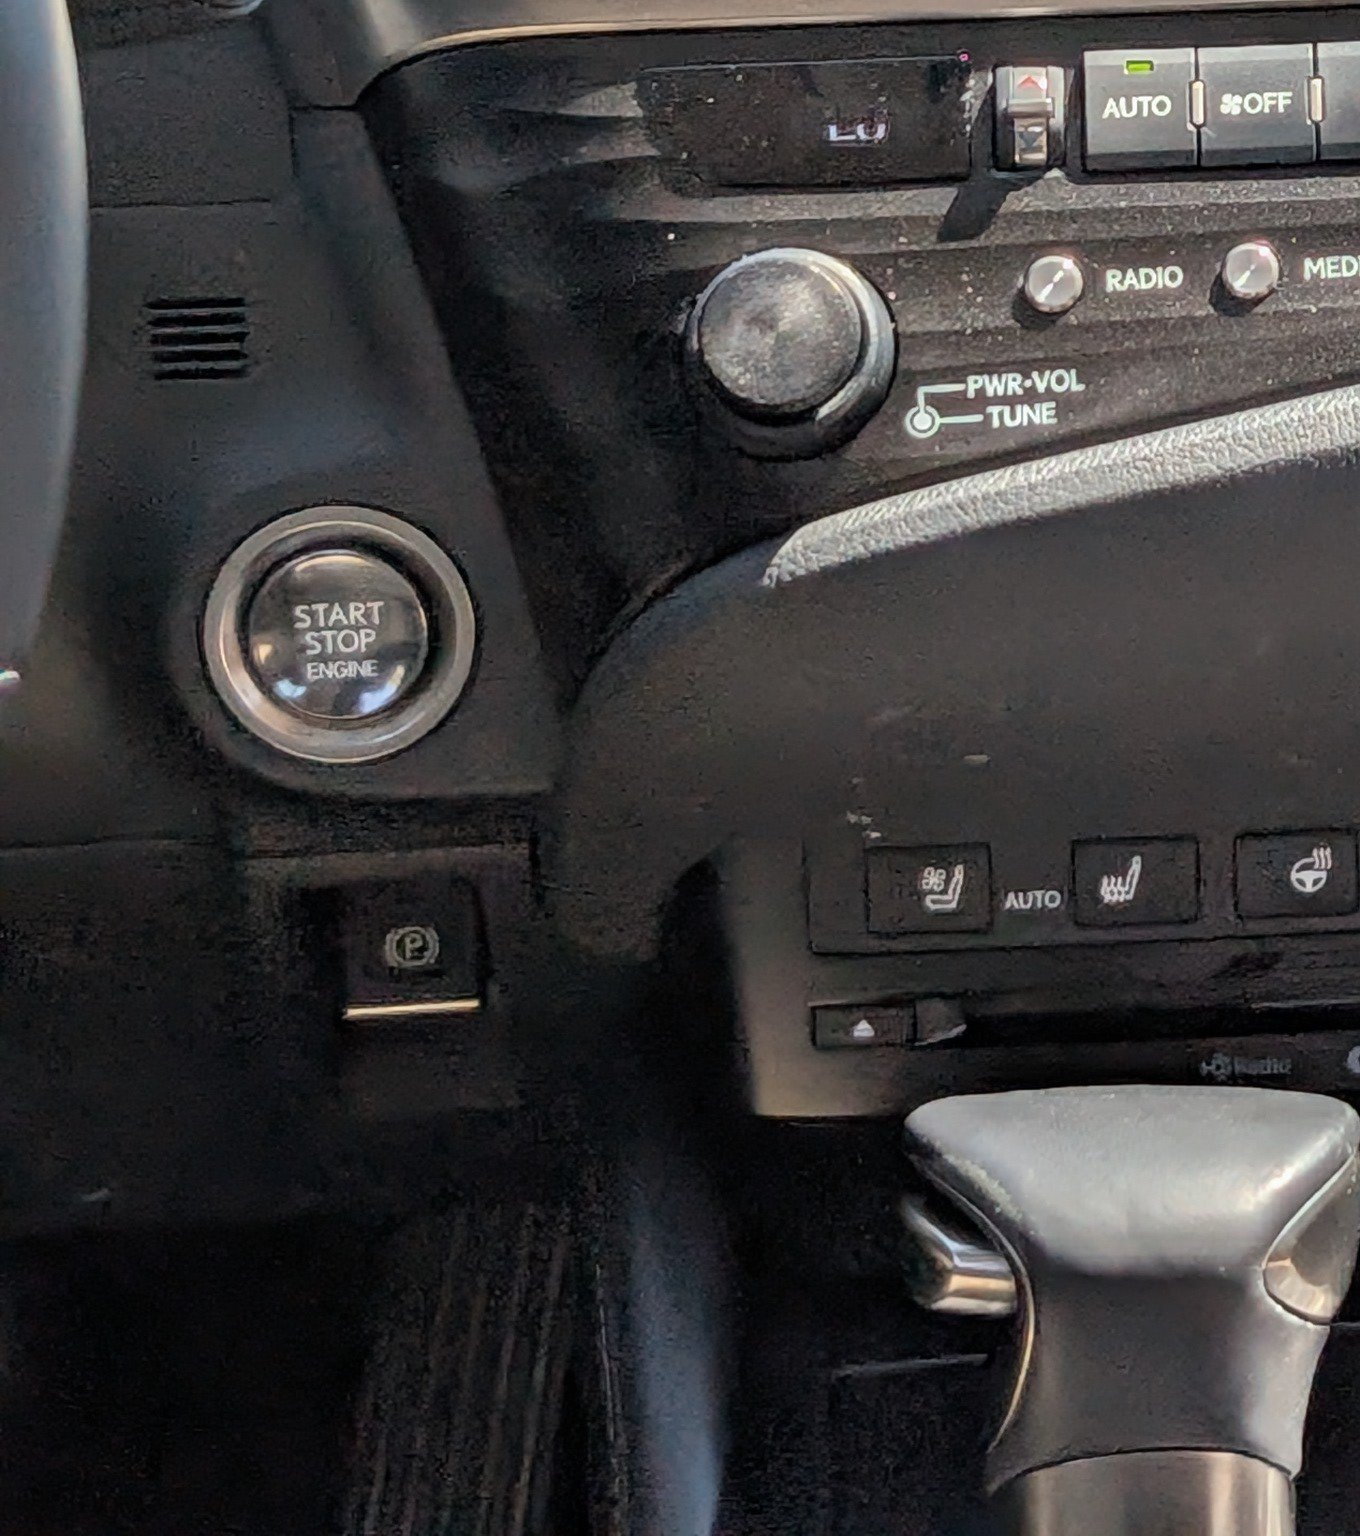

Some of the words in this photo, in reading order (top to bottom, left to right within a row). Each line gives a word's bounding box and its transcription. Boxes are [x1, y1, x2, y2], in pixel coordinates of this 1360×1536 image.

[1102, 95, 1172, 119] AUTO
[1243, 92, 1293, 115] OFF
[1105, 265, 1184, 293] RADIO
[986, 401, 1058, 427] TUNE
[294, 601, 385, 629] START
[305, 629, 376, 655] STOP
[307, 659, 379, 681] ENGINE
[1004, 888, 1062, 910] AUTO
